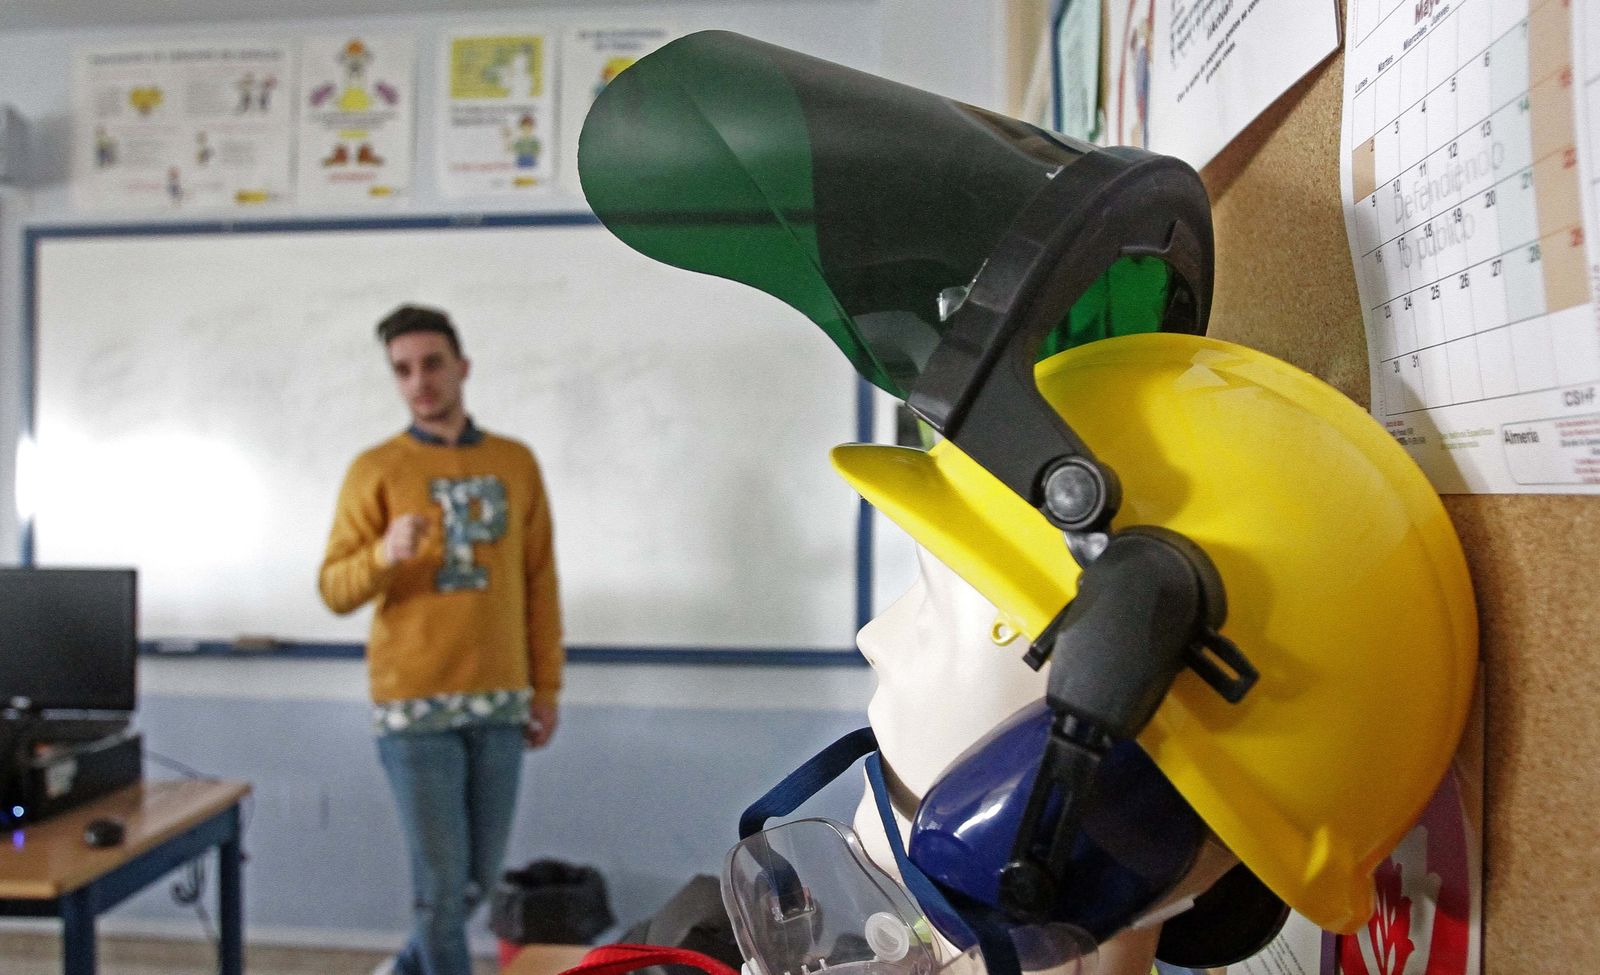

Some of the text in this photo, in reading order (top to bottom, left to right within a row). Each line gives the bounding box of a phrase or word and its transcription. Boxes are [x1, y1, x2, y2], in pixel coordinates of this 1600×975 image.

[1355, 77, 1368, 93] Lunes
[1377, 54, 1393, 73] Martes
[1394, 120, 1399, 134] 3
[1421, 99, 1427, 113] 4
[1450, 76, 1457, 92] 5
[1484, 50, 1490, 67] 6
[1371, 194, 1376, 208] 9
[1393, 178, 1400, 193] 10
[1419, 161, 1427, 177] 11
[1448, 141, 1458, 159] 12
[1481, 120, 1492, 138] 13
[1397, 236, 1405, 252] 17
[1423, 222, 1433, 239] 18
[1452, 207, 1463, 223] 19
[1484, 190, 1496, 208] 20
[1403, 295, 1413, 310] 24
[1430, 284, 1440, 300] 25
[1460, 273, 1470, 289] 26
[1491, 259, 1502, 277] 27
[1412, 354, 1420, 368] 31
[429, 475, 508, 592] P
